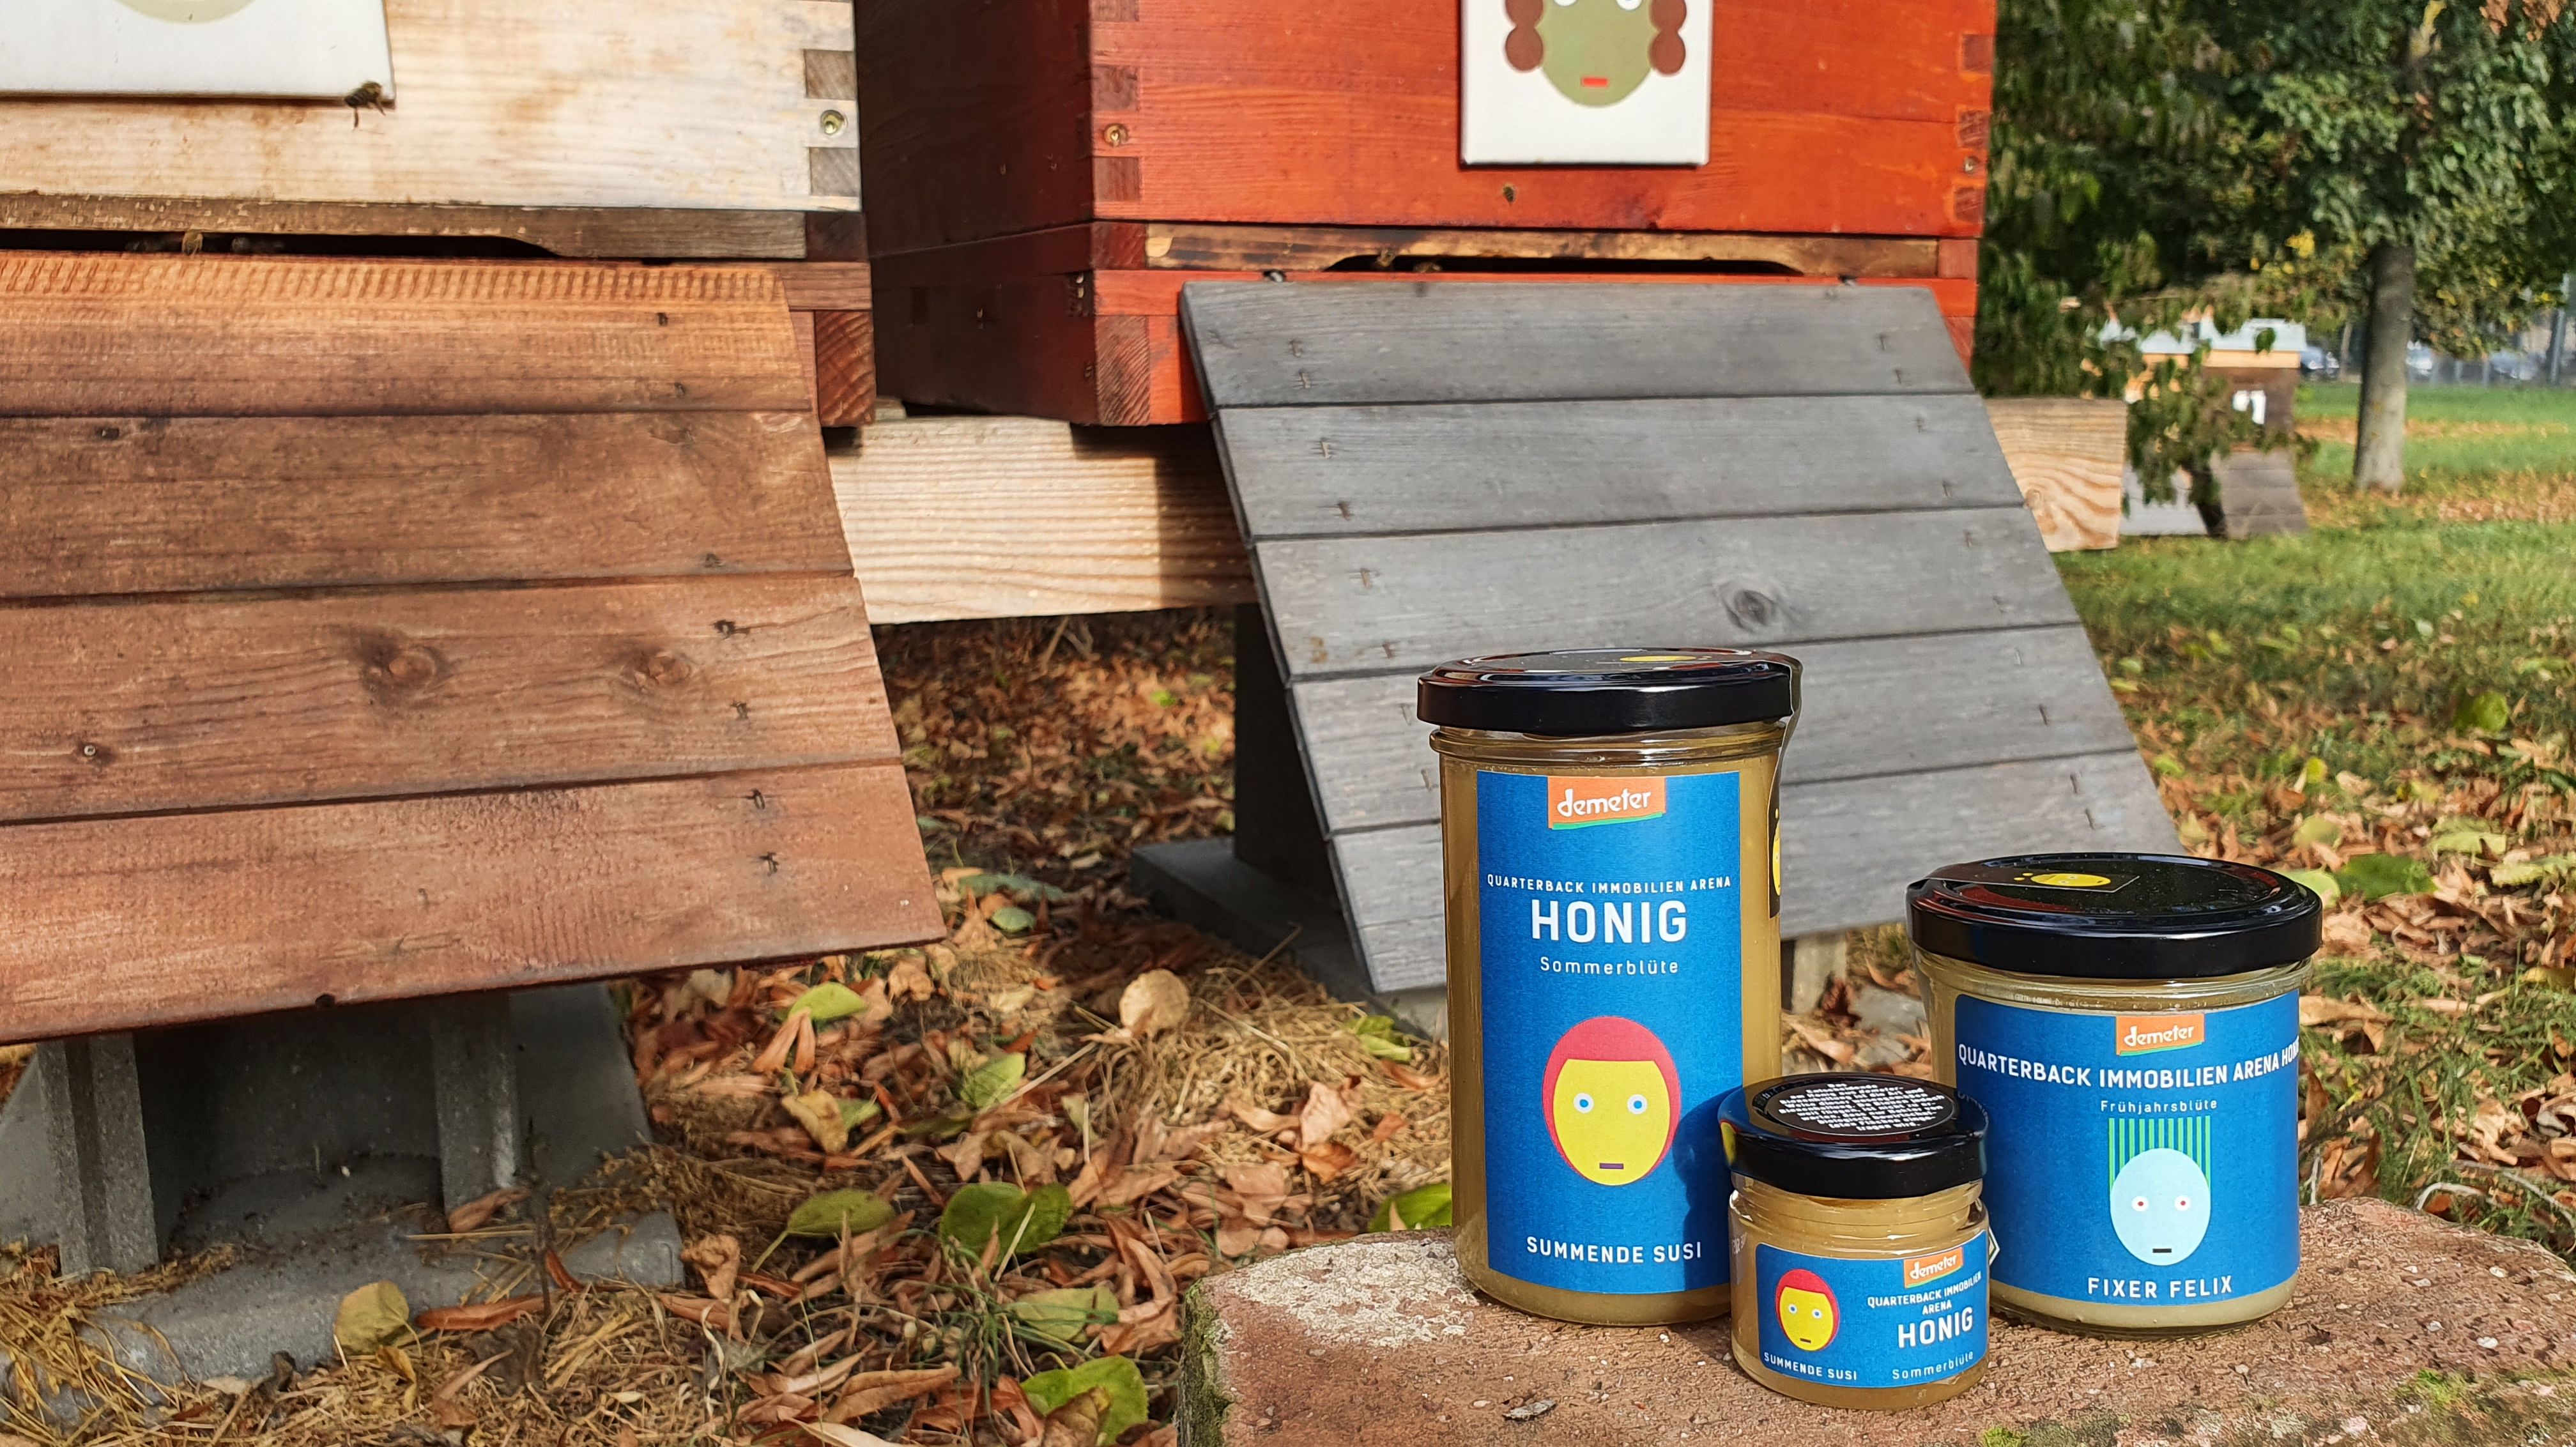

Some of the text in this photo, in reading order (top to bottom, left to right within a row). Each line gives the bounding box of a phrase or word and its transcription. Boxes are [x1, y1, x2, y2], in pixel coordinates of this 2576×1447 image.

[1557, 789, 1652, 818] demeter
[1487, 874, 1731, 894] QUARTERBACK IMMOBILIEN ARENA
[1531, 899, 1687, 944] HONIG
[1540, 956, 1678, 975] Sommerblüte
[2124, 1025, 2195, 1046] demeter
[1959, 1035, 2299, 1089] QUARTERBACK IMMOBILIEN ARENA HON
[2101, 1099, 2217, 1115] Frühjahrsblüte
[1527, 1236, 1701, 1263] SUMMENDE SUSI
[1909, 1253, 1958, 1280] demeter
[1867, 1270, 1982, 1308] QUARTERBACK IMMOBILIEN
[2088, 1275, 2232, 1298] FIXER FELIX
[1922, 1300, 1952, 1315] ARENA
[1898, 1306, 1973, 1348] HONIG
[1763, 1352, 1857, 1381] SUMMENDE SUSI
[1892, 1352, 1974, 1380] Sommerblüte
